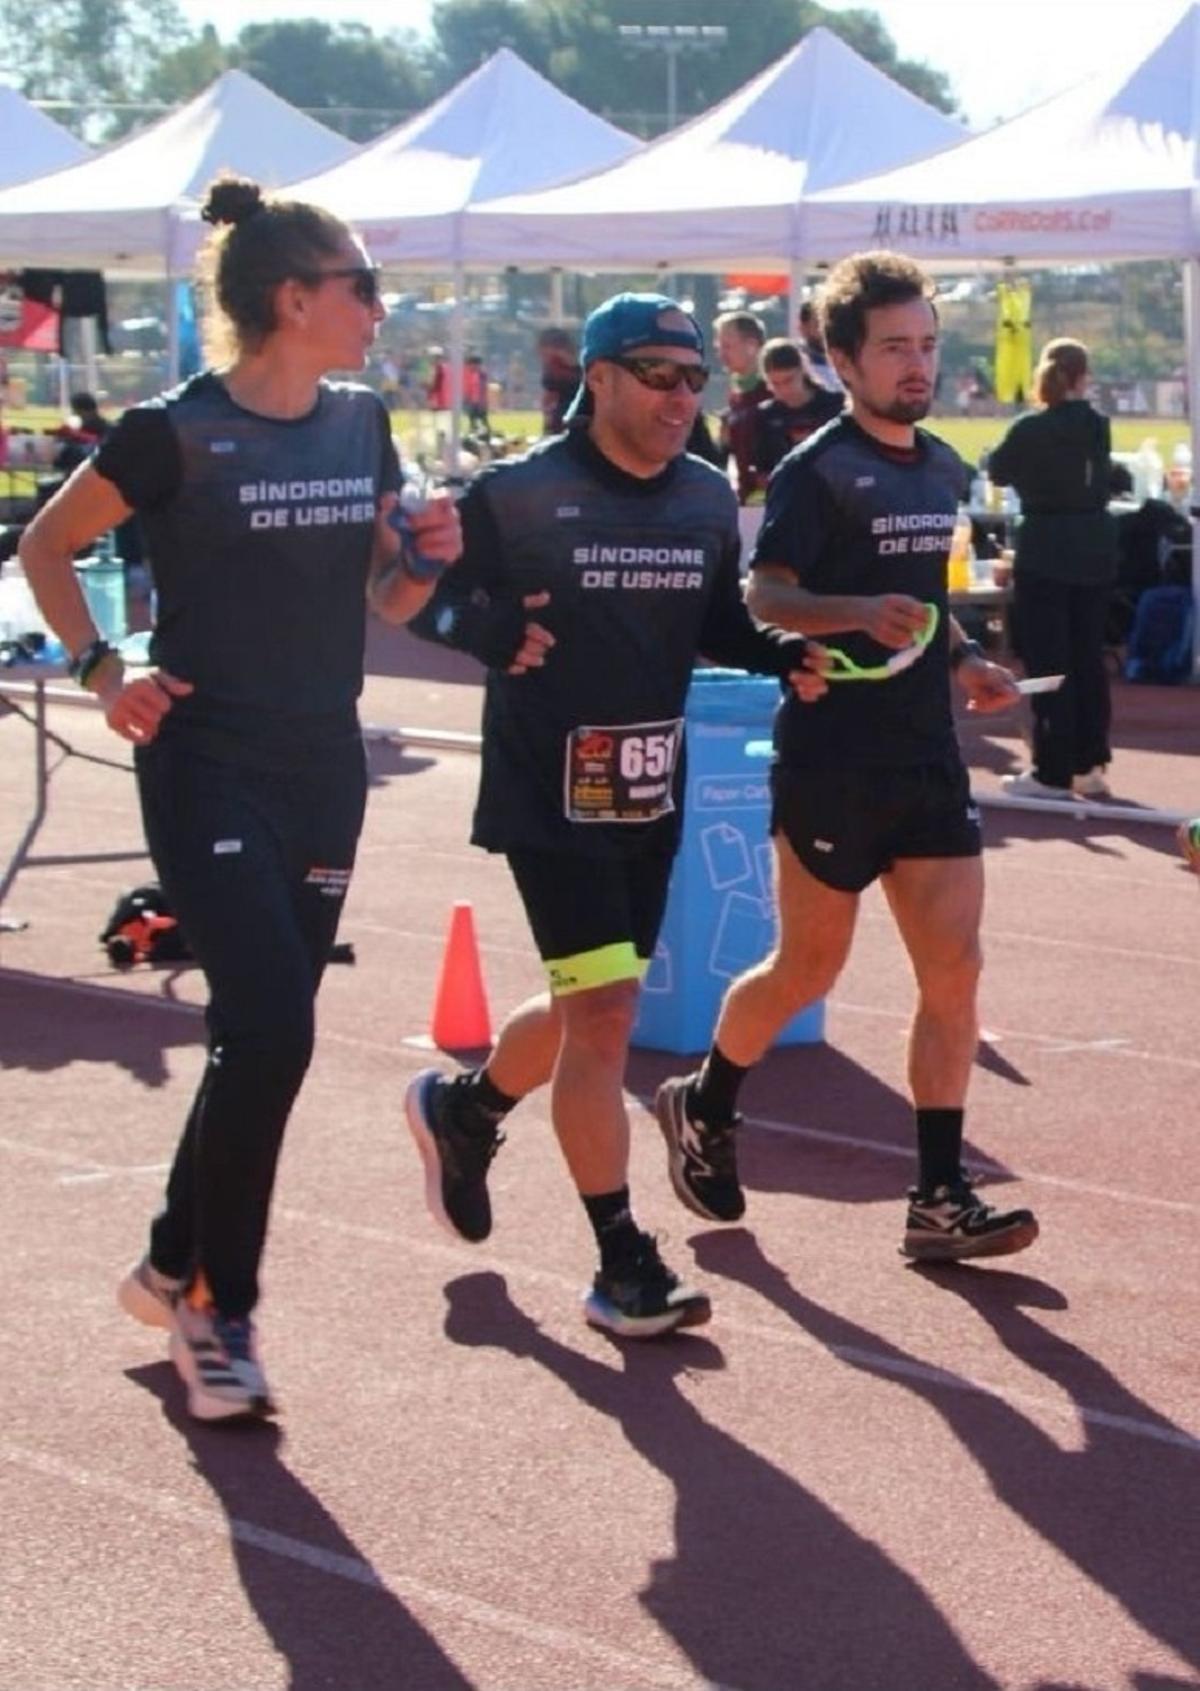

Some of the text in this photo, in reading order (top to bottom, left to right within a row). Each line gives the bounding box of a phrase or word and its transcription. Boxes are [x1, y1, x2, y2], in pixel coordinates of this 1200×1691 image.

[250, 503, 375, 530] DE USHER
[870, 513, 956, 535] SÍNDROM
[572, 544, 704, 565] SÍNDROME
[878, 537, 909, 555] DE
[581, 570, 704, 589] DE USHER
